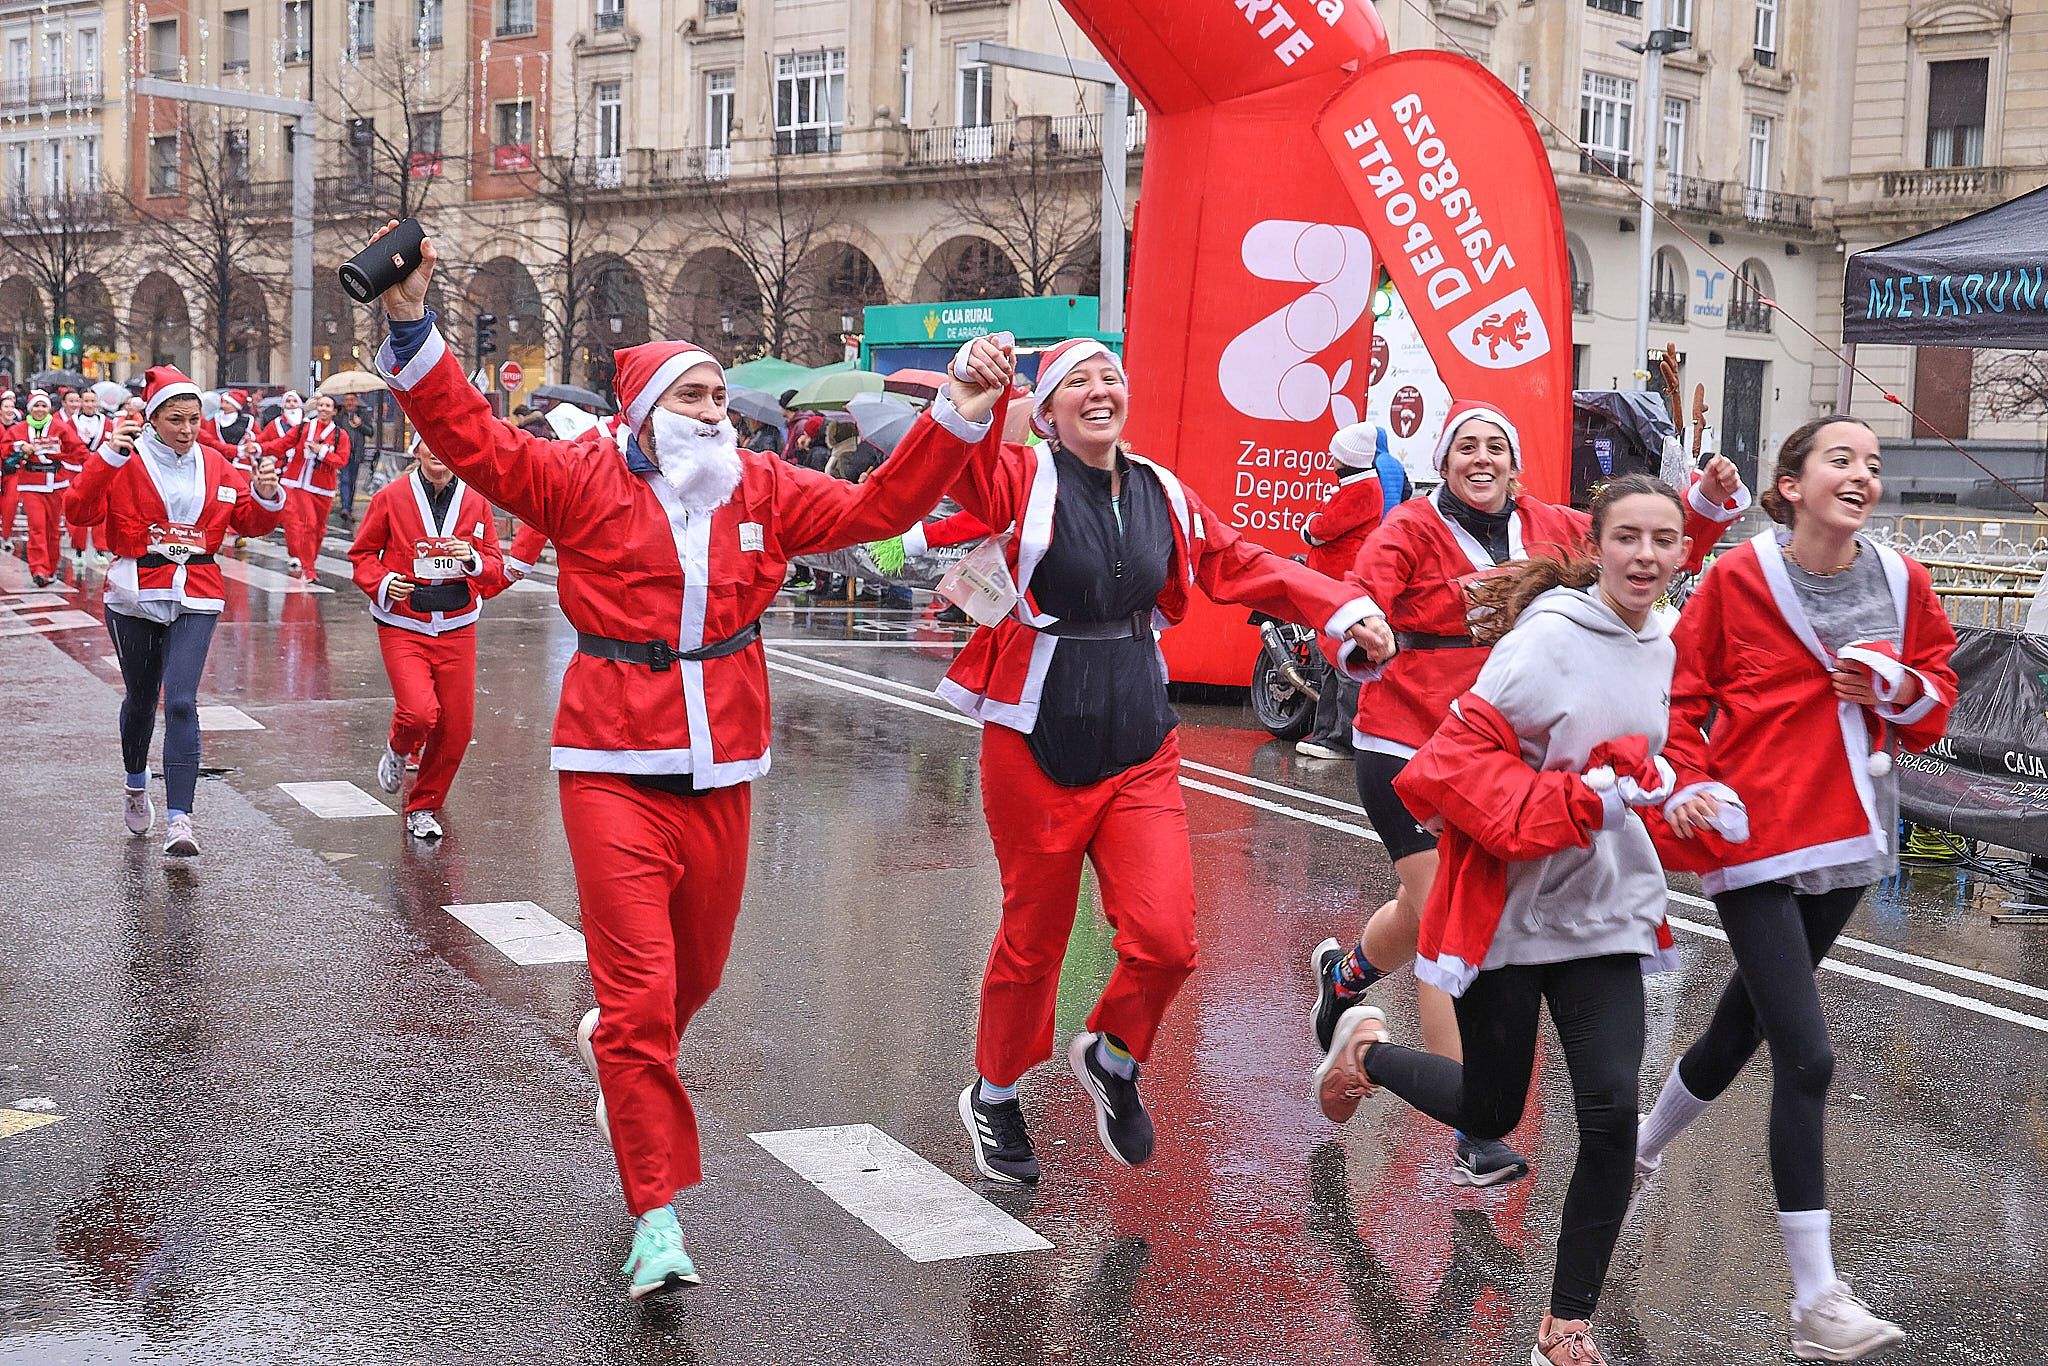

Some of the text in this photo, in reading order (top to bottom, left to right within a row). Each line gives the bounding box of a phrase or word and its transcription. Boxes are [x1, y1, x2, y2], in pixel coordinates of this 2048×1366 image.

[1866, 265, 2048, 320] METARUN
[941, 307, 994, 325] CAJA RURAL
[946, 325, 988, 339] DE ARAGÓN
[1234, 471, 1333, 506] Deporte
[434, 558, 453, 569] 910
[1895, 752, 1950, 777] ARAGÓN
[2003, 750, 2048, 779] CAJA
[2009, 781, 2034, 796] DE
